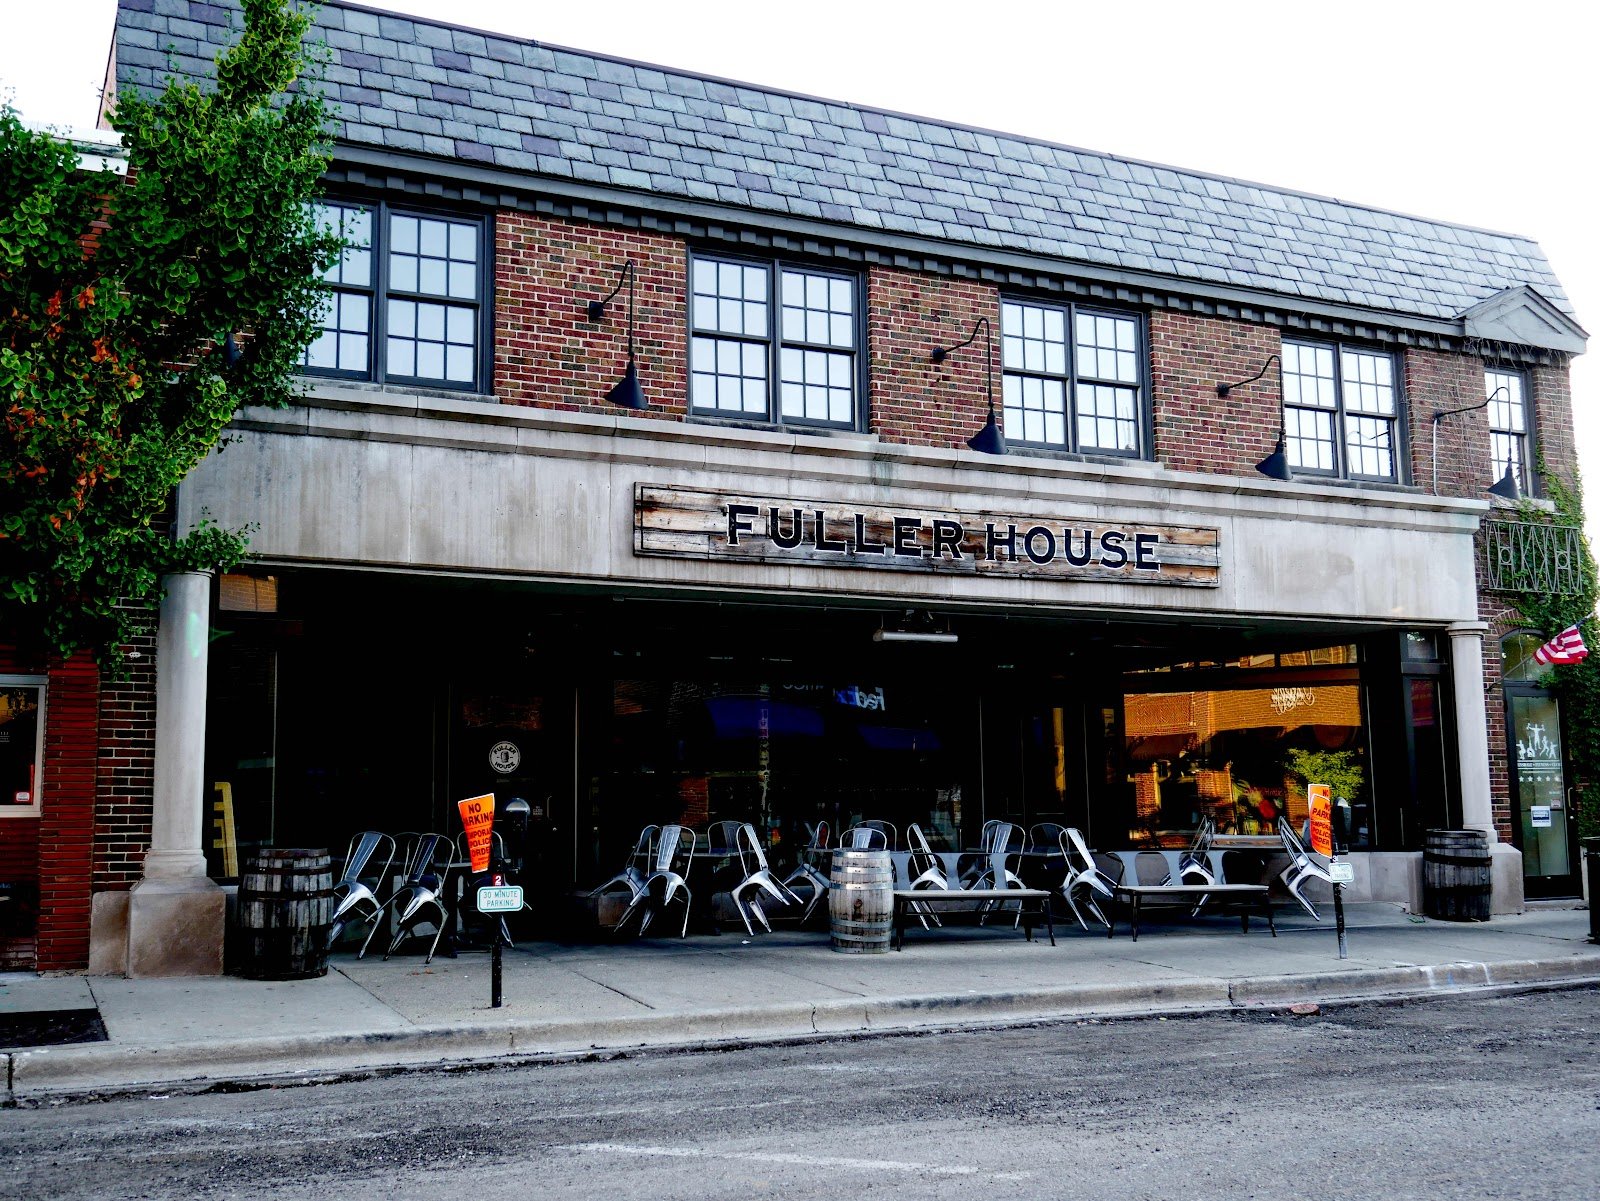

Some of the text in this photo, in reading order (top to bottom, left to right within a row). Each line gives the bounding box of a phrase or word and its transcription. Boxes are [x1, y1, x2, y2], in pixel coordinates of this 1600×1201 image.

[726, 503, 1161, 573] FULLER HOUSE
[493, 744, 517, 755] FULLER
[494, 761, 516, 770] HOUSE
[468, 803, 482, 814] NO
[1312, 808, 1331, 819] PARK
[462, 811, 494, 827] ARKING
[469, 838, 491, 849] POLIC
[471, 847, 489, 857] ORDE
[495, 875, 502, 884] 2
[483, 890, 518, 899] 30 MINUTE
[486, 900, 514, 908] PARKING
